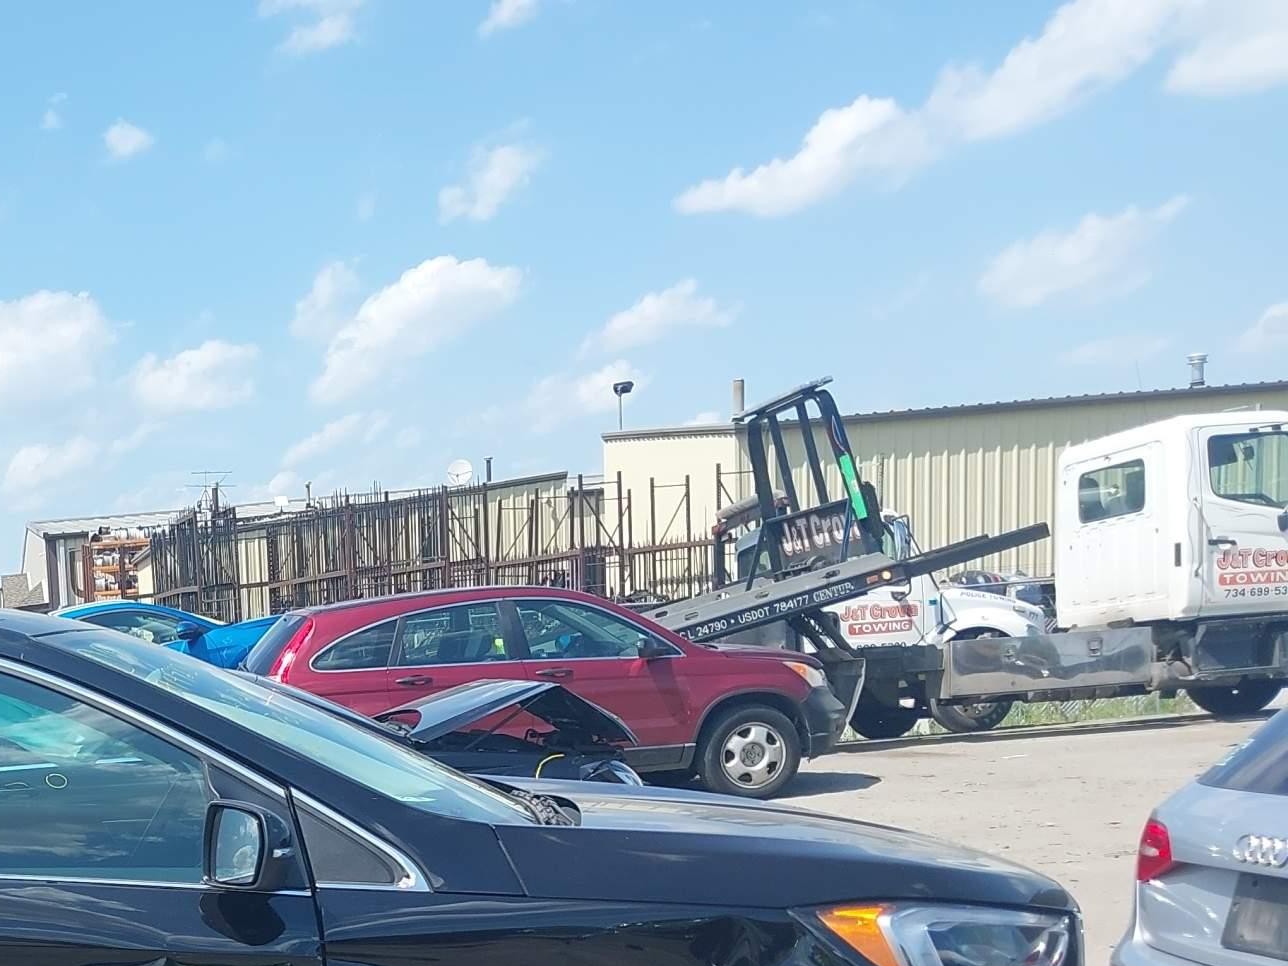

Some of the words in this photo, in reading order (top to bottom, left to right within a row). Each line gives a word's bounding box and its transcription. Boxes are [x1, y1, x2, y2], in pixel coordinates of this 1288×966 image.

[782, 517, 811, 557] J&T
[1217, 549, 1252, 570] J&T
[696, 619, 728, 637] 24790
[737, 606, 770, 624] USDOT
[773, 594, 809, 613] 784177
[813, 582, 855, 602] CENTUR
[840, 605, 869, 622] J&T
[853, 621, 910, 634] TOWING
